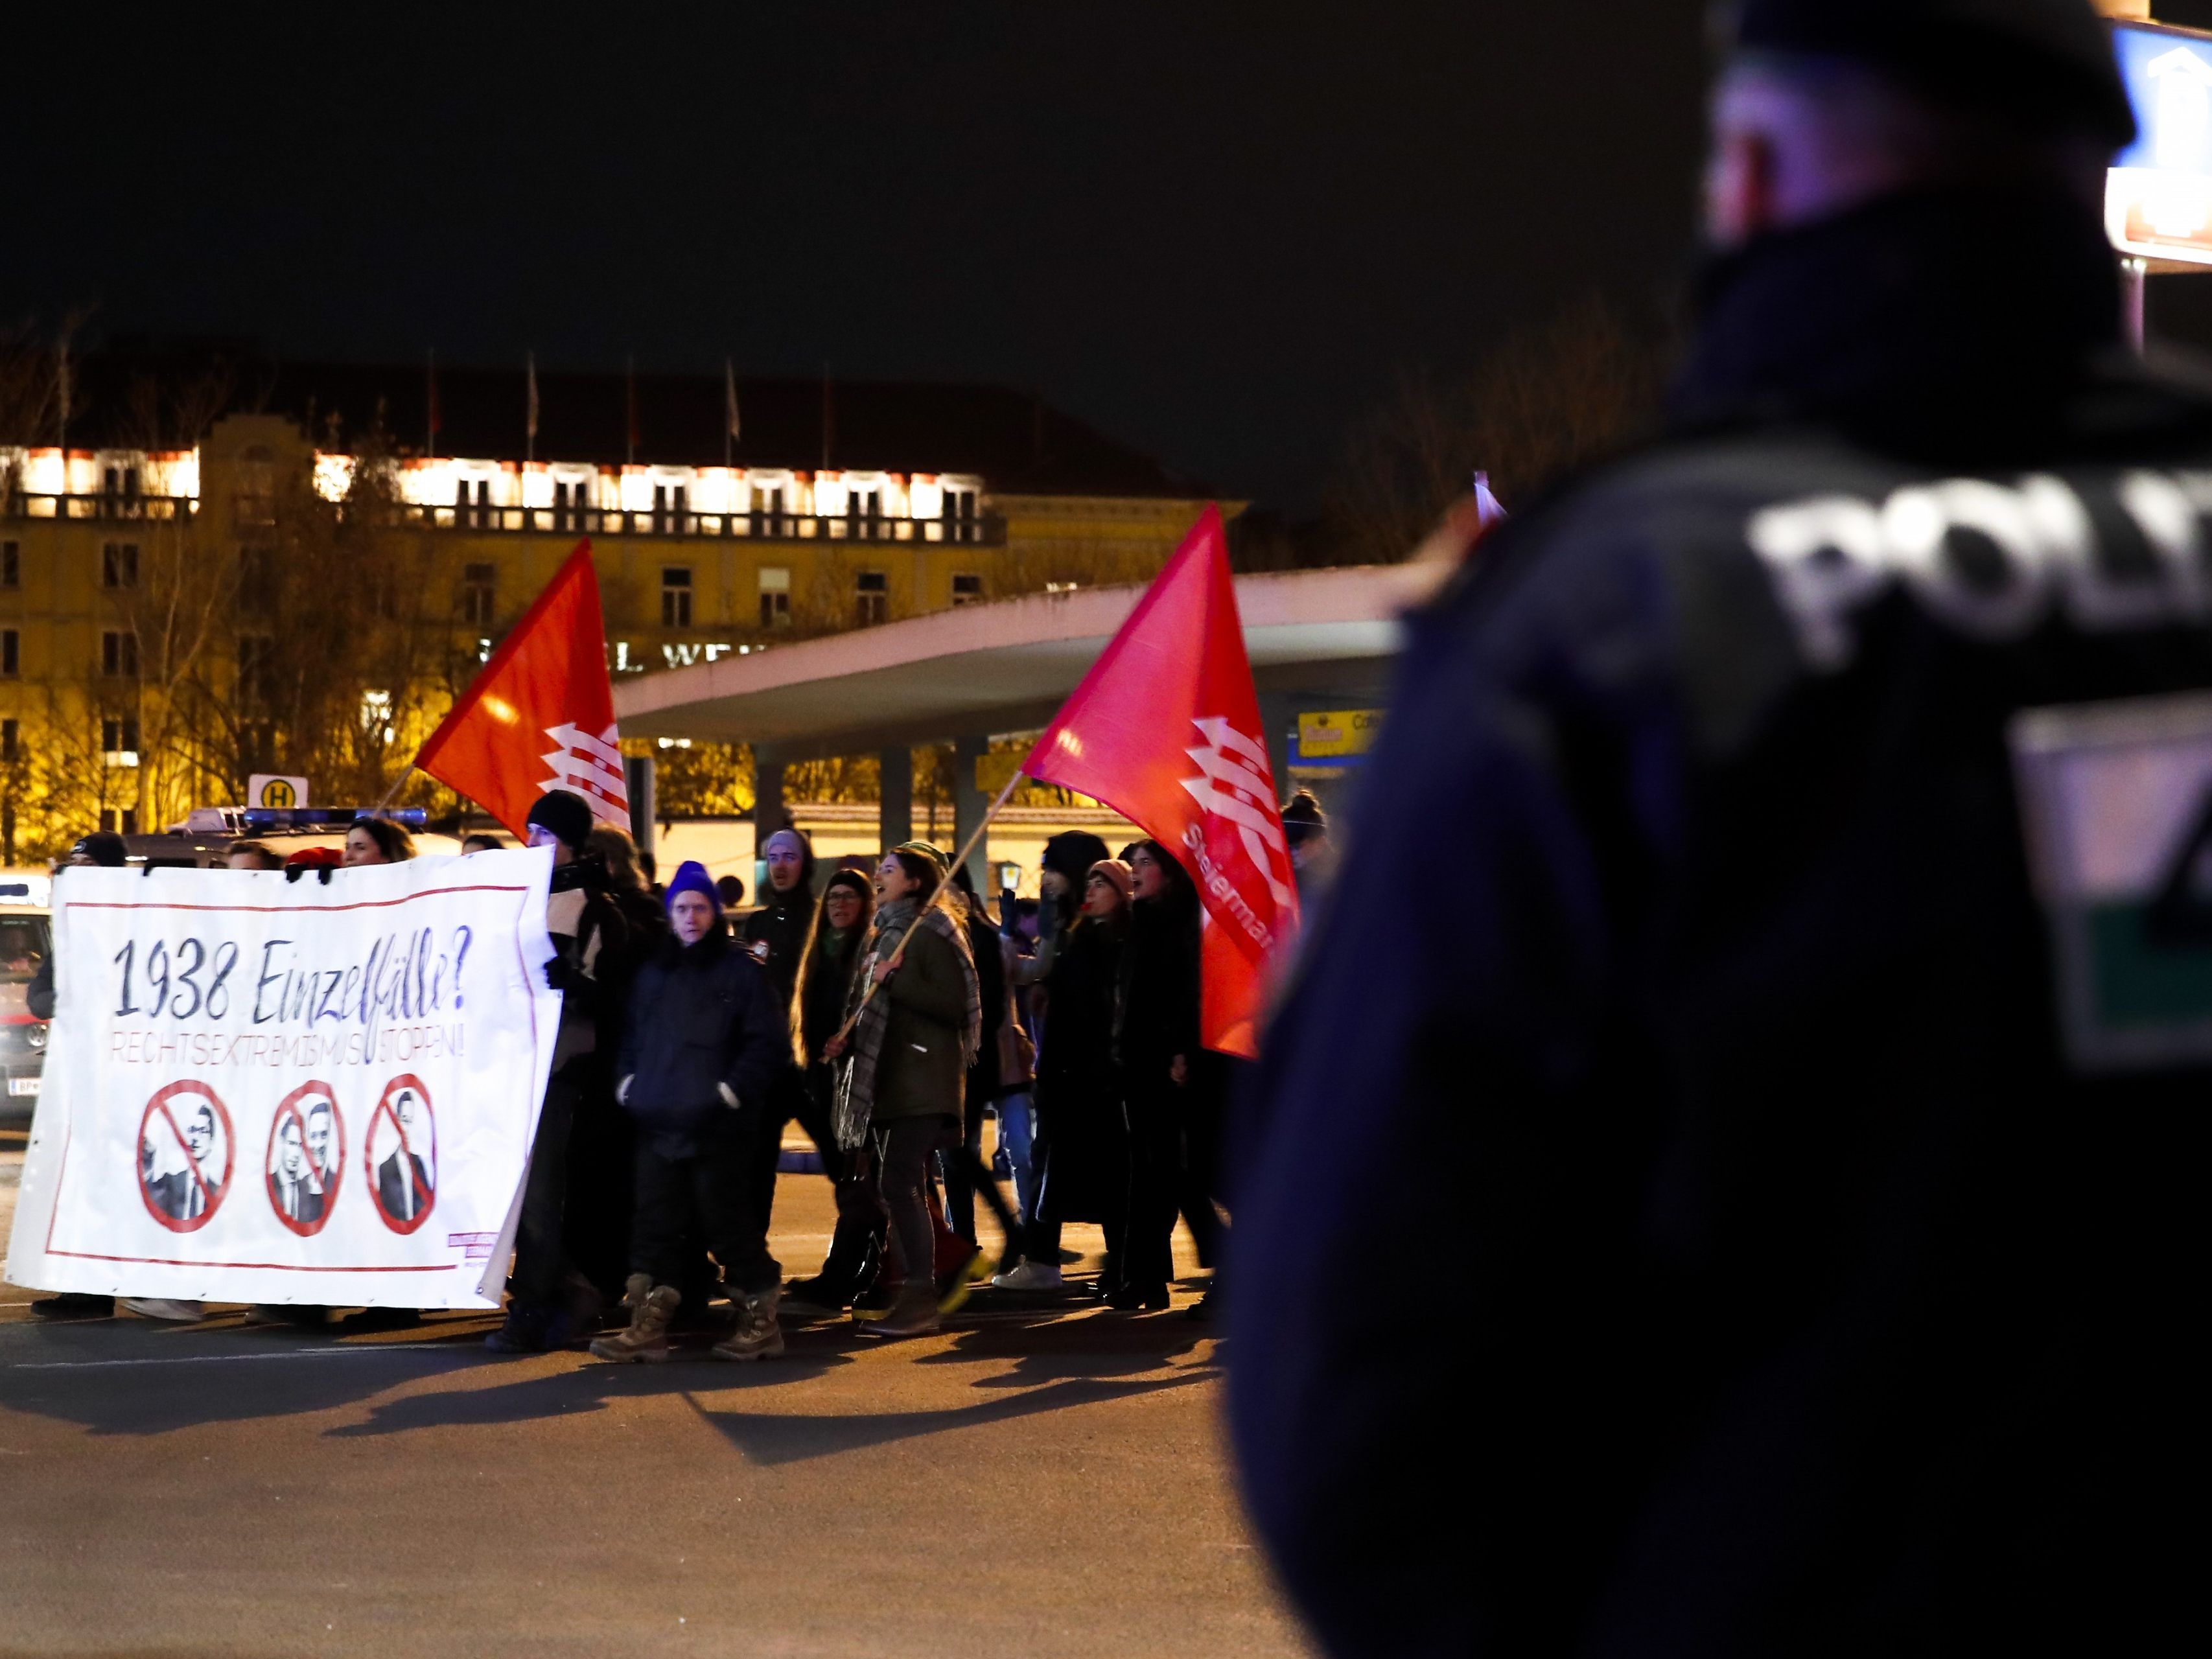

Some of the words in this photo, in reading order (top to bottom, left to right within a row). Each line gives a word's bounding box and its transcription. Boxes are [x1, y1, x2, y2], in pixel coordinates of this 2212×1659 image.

[1746, 468, 2212, 673] POLI
[270, 786, 287, 807] H
[1182, 822, 1275, 950] Steiermar
[115, 937, 239, 1020] 1938
[253, 924, 474, 1065] Einzelfälle?
